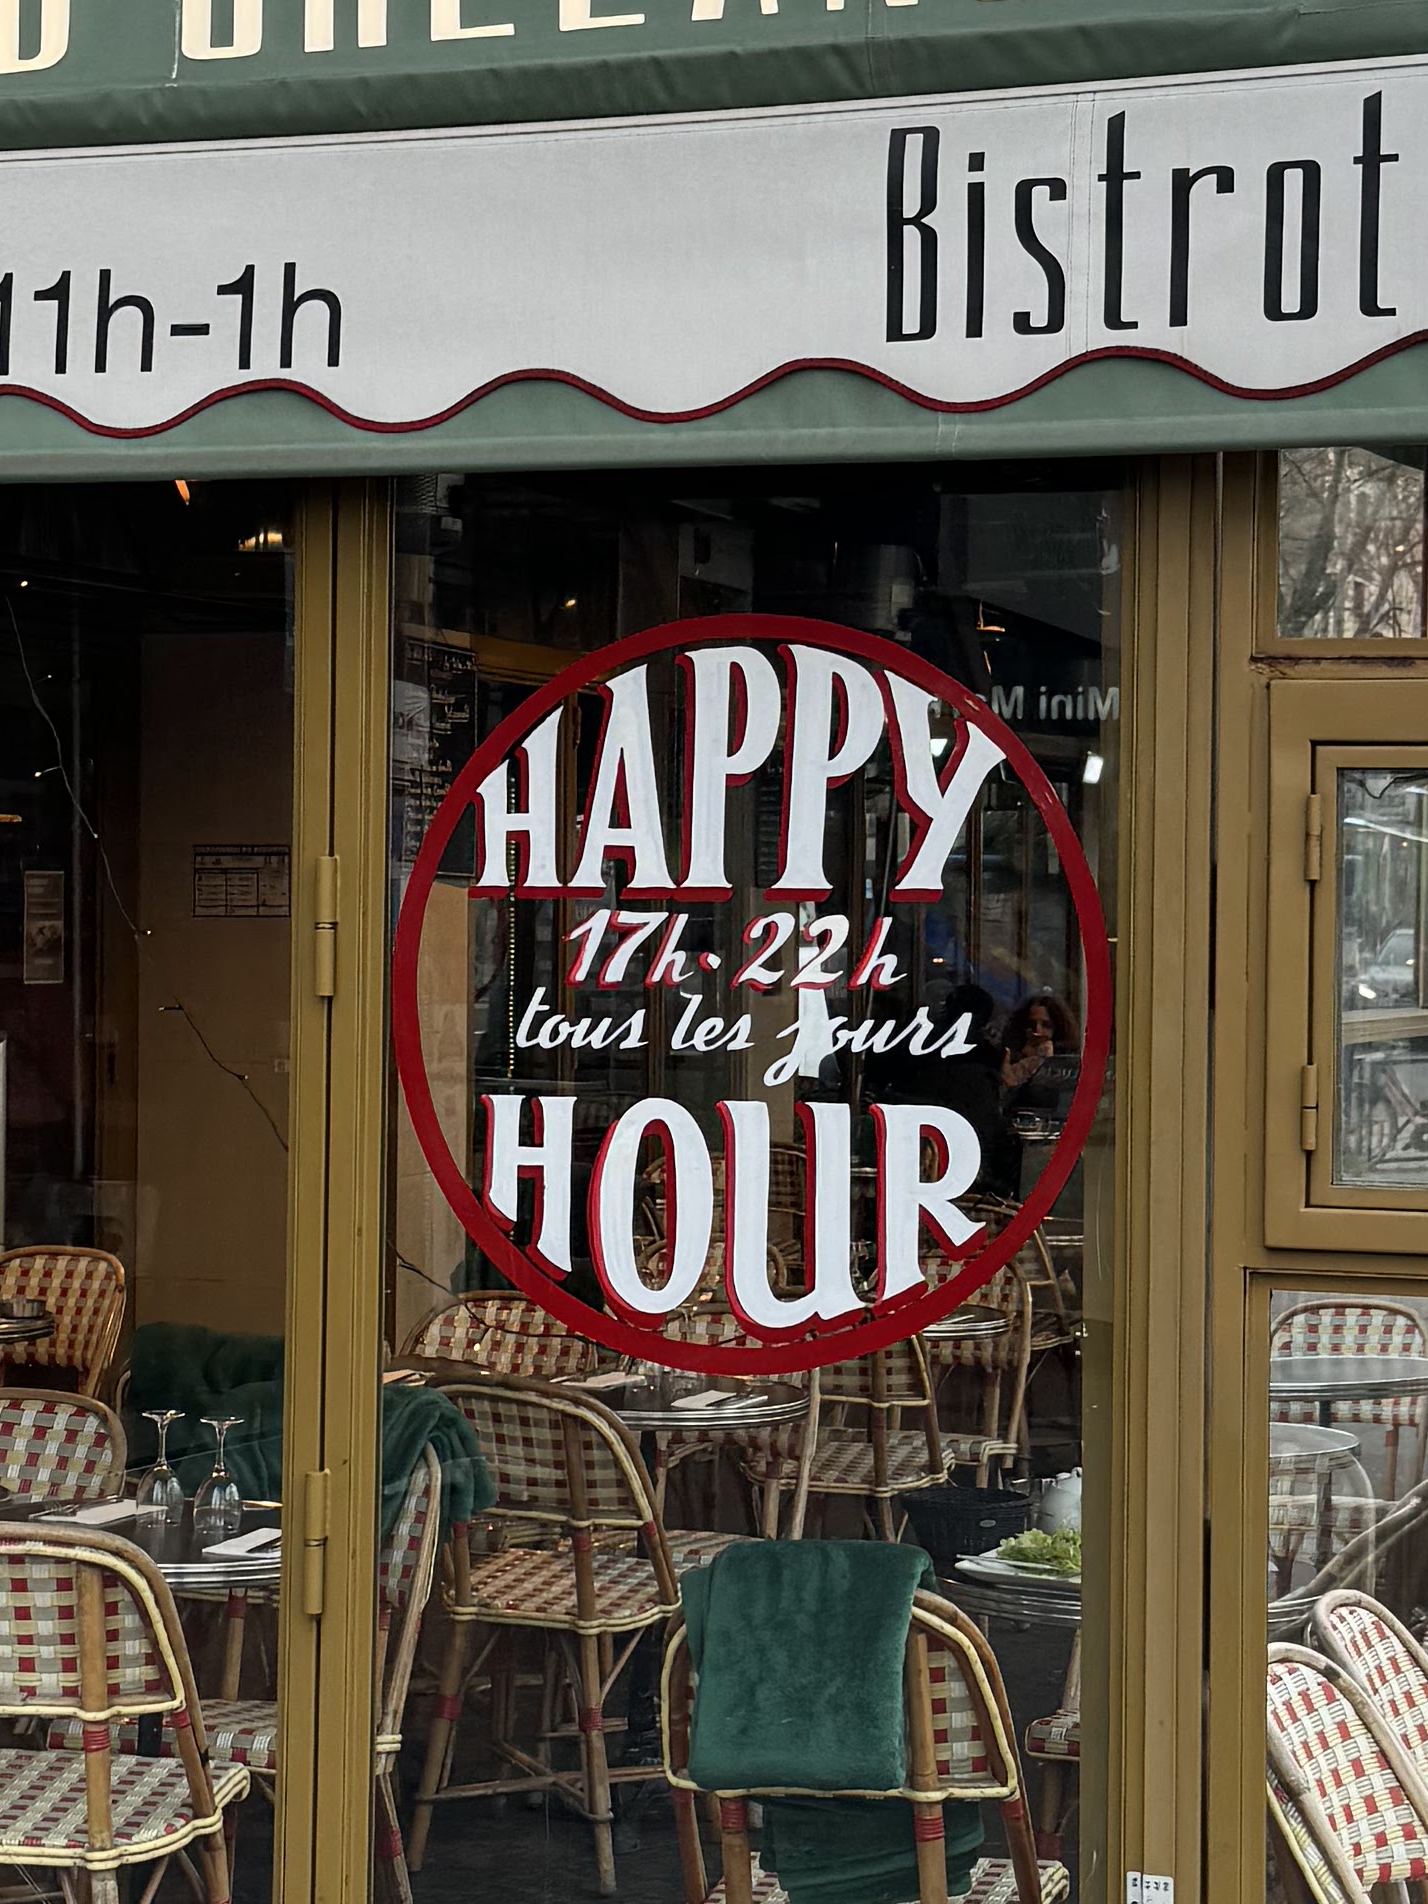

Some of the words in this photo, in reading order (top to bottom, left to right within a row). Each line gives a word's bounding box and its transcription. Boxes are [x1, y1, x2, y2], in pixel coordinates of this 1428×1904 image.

[885, 89, 1400, 343] Bistrot
[469, 643, 1008, 901] HAPPY
[515, 986, 648, 1050] tous
[670, 990, 754, 1052] les
[763, 1005, 977, 1086] jours
[482, 1093, 988, 1343] HOUR
